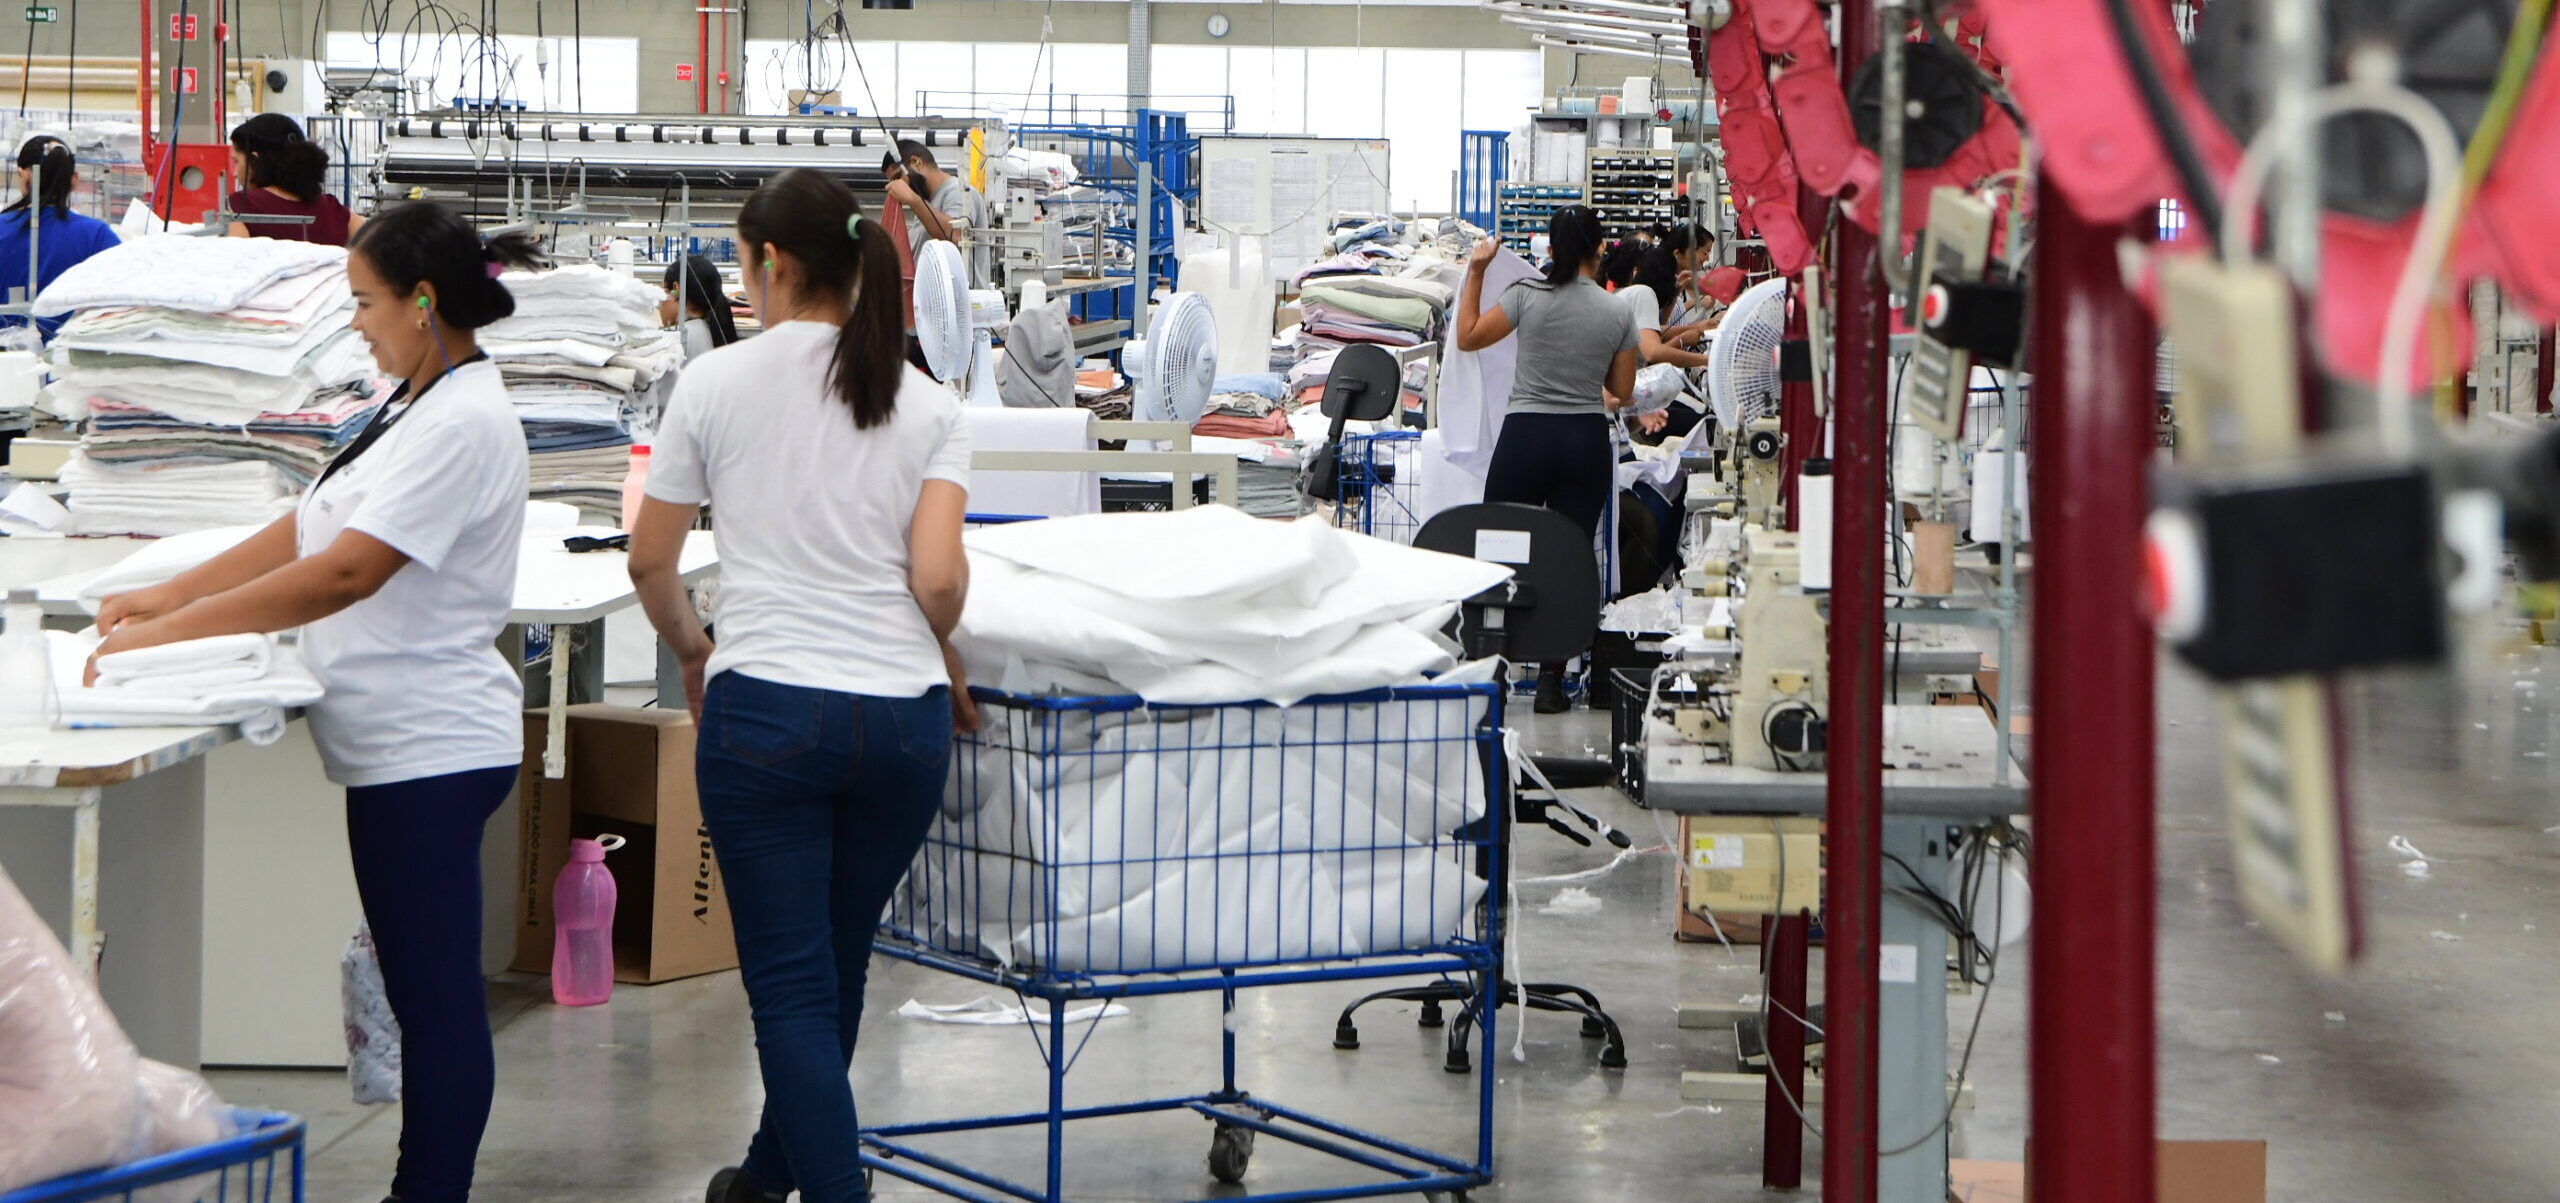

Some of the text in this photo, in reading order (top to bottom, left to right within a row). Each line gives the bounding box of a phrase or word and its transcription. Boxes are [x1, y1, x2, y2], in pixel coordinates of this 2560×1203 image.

[527, 782, 542, 917] ESTE LADO PARA CIMA
